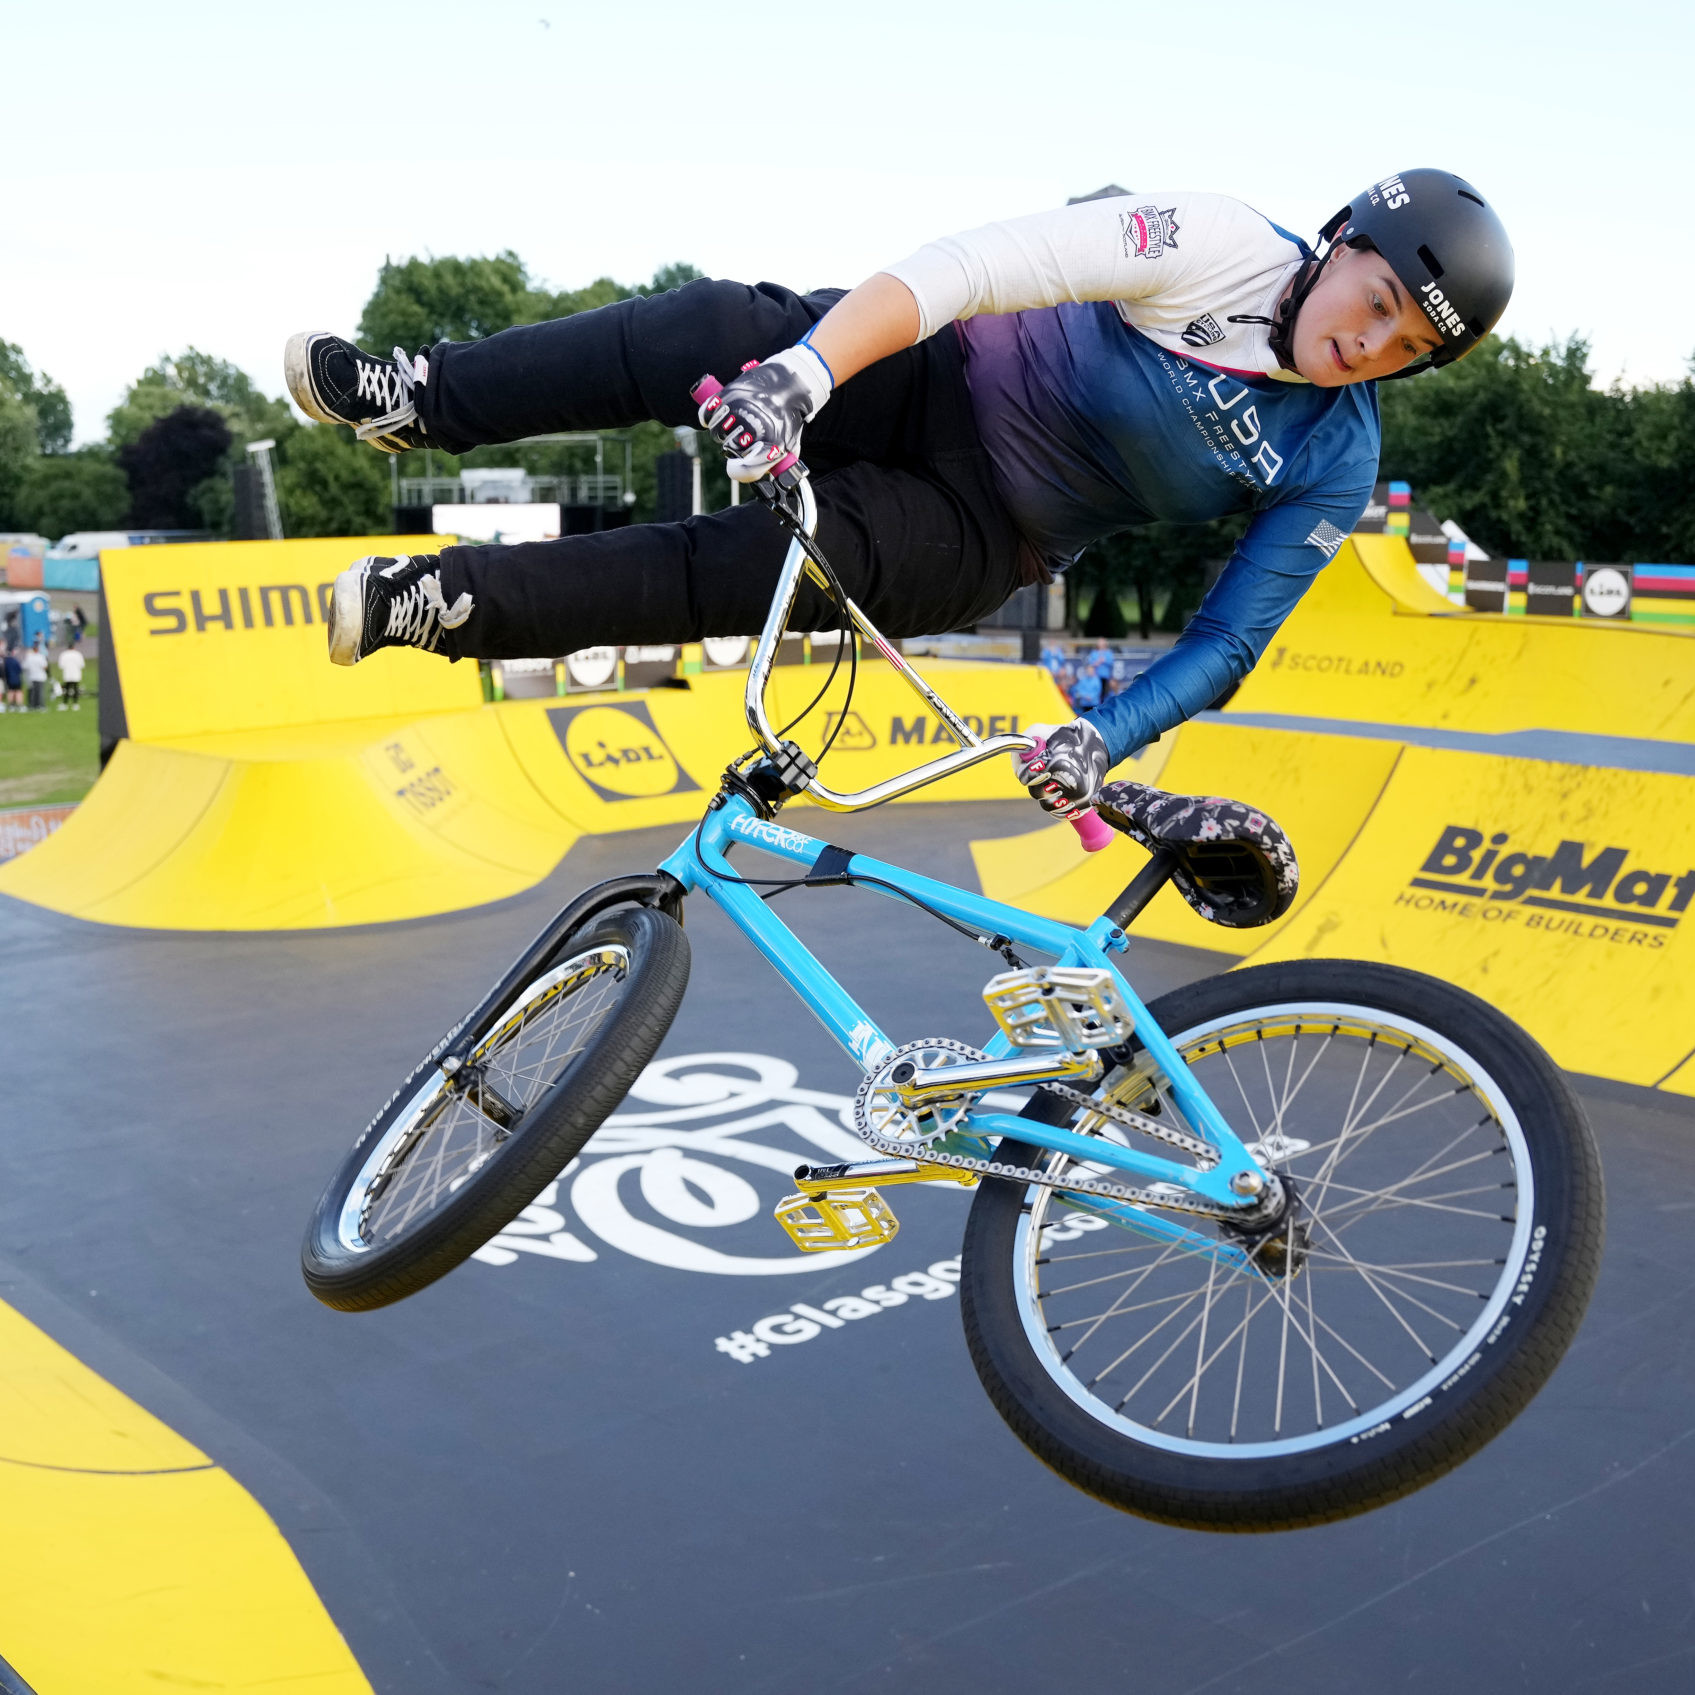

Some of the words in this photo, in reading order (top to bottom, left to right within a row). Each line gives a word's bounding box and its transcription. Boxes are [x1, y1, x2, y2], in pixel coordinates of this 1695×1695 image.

[1379, 175, 1411, 210] NES
[1147, 220, 1162, 254] FREESTYLE
[1199, 313, 1221, 339] USA
[1420, 281, 1466, 337] JONES
[1422, 301, 1439, 323] SODA
[1157, 351, 1184, 394] WORLD
[1175, 358, 1207, 402] BMX
[1207, 373, 1284, 486] USA
[1288, 653, 1405, 678] SCOTLAND
[1419, 824, 1695, 913] BigMat
[1395, 891, 1474, 919] HOME
[1481, 905, 1521, 924] OF
[1525, 912, 1669, 949] BUILDERS
[1511, 1225, 1547, 1306] ODYSSEY
[714, 1254, 962, 1365] #Glasgo
